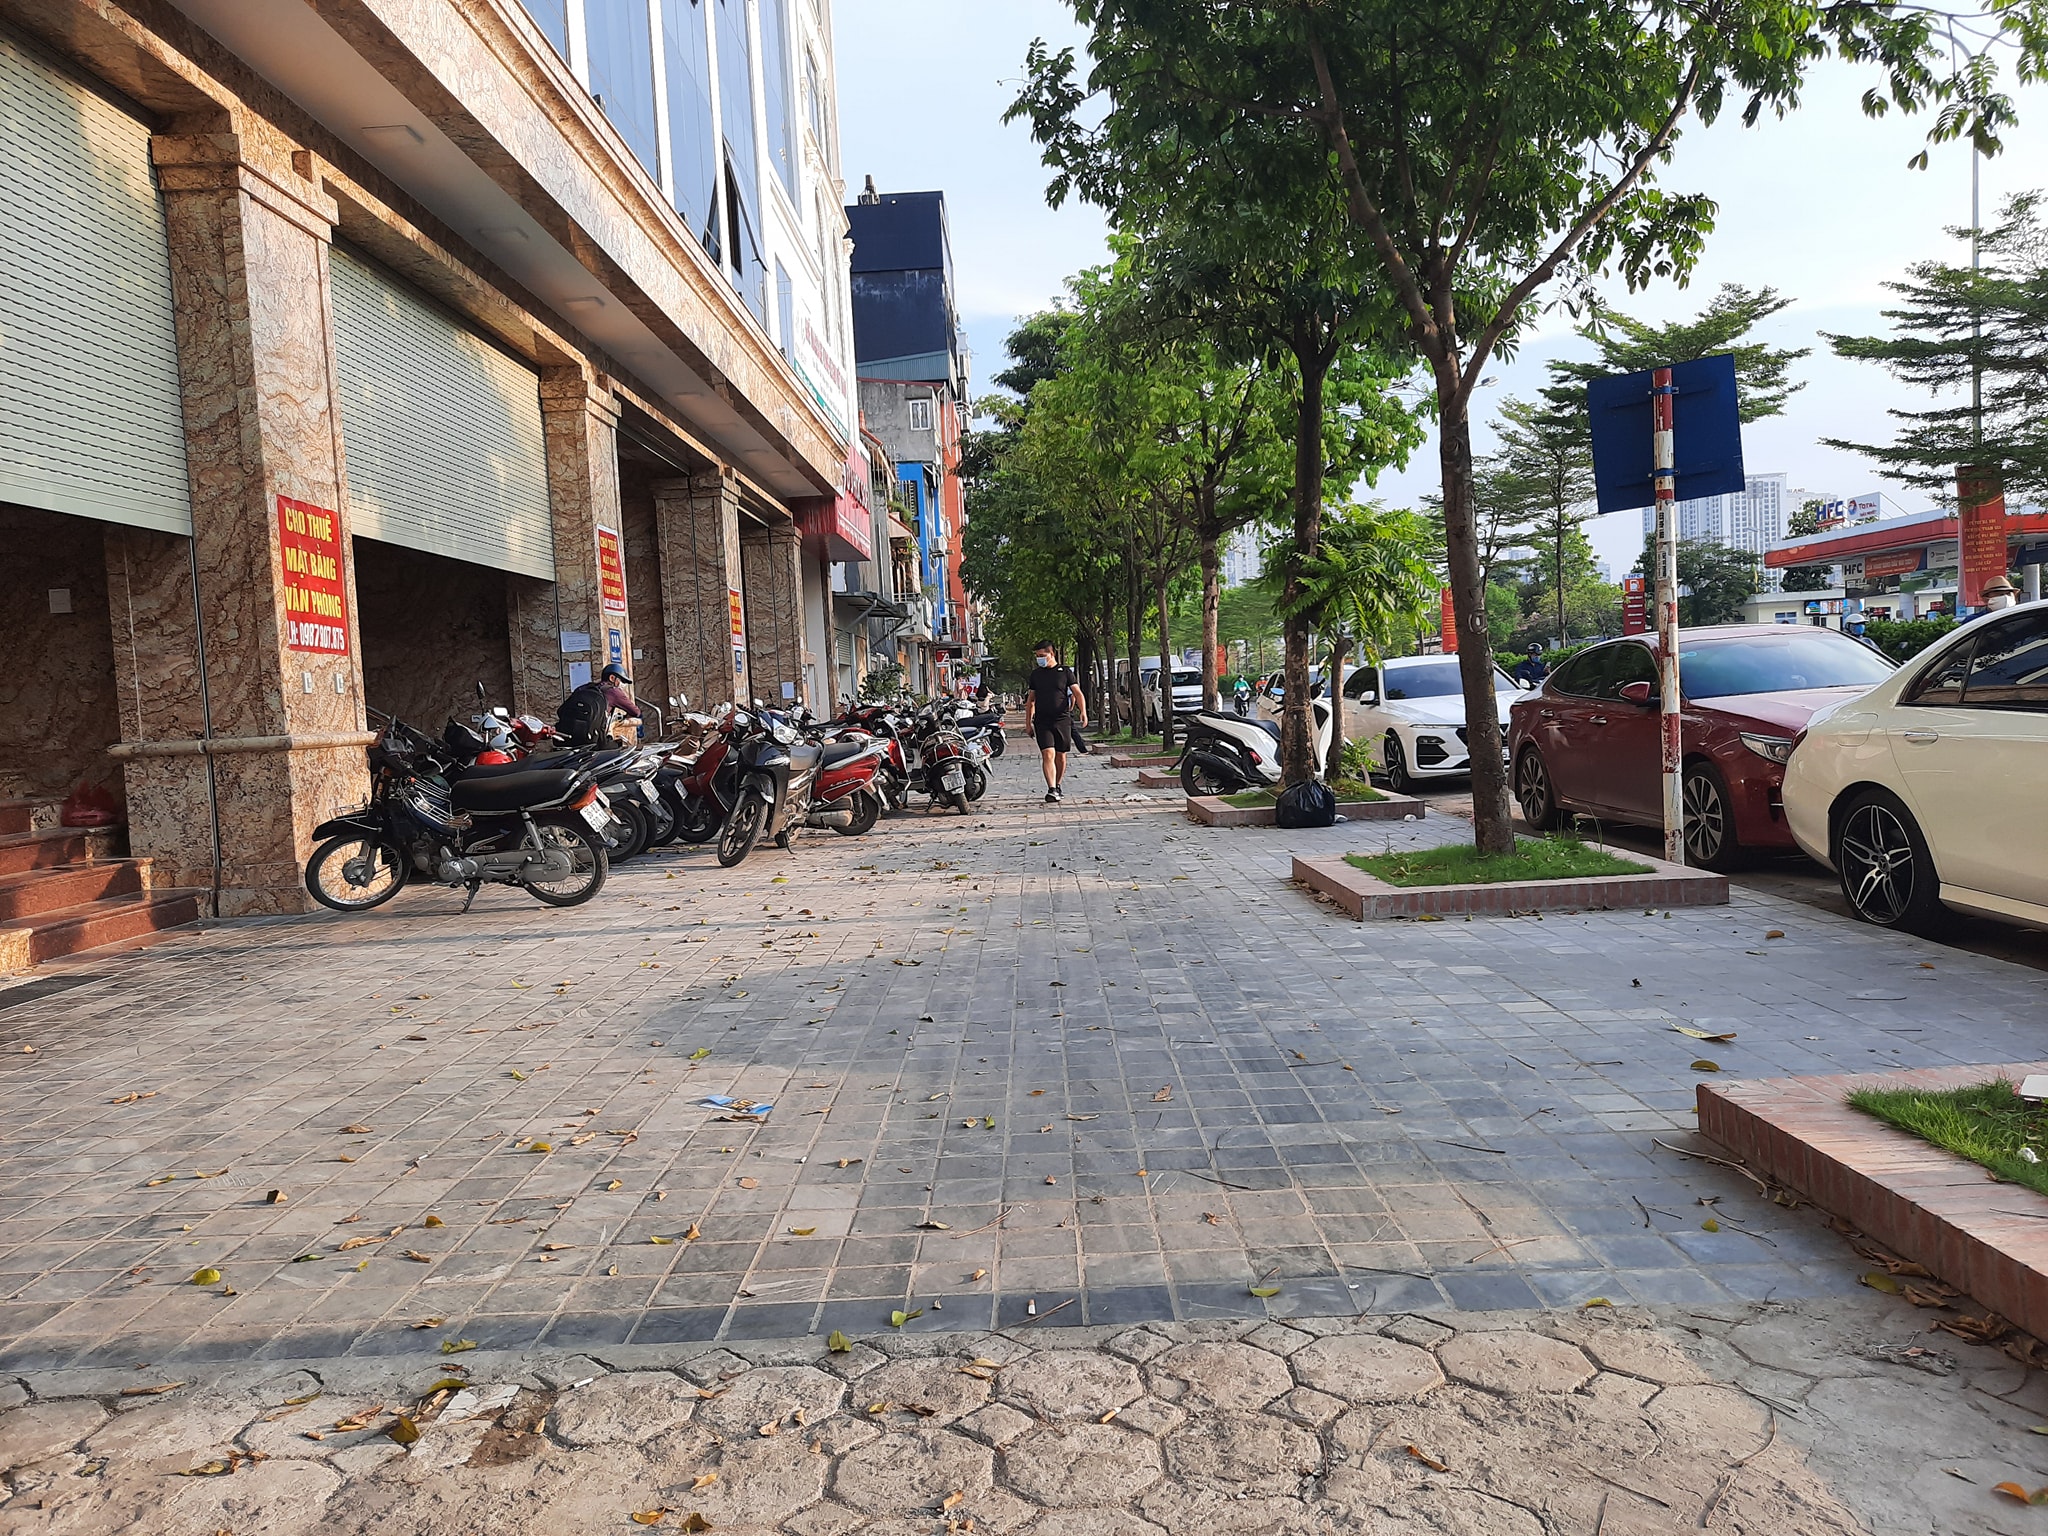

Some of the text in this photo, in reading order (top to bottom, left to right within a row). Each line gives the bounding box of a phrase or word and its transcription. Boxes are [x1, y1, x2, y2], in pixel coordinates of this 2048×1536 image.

[285, 506, 333, 542] CHO THUÊ
[1816, 500, 1844, 521] HFC
[284, 543, 337, 581] MẶT BẰNG
[1844, 563, 1863, 576] HFC
[285, 582, 342, 619] VĂN PHÒNG
